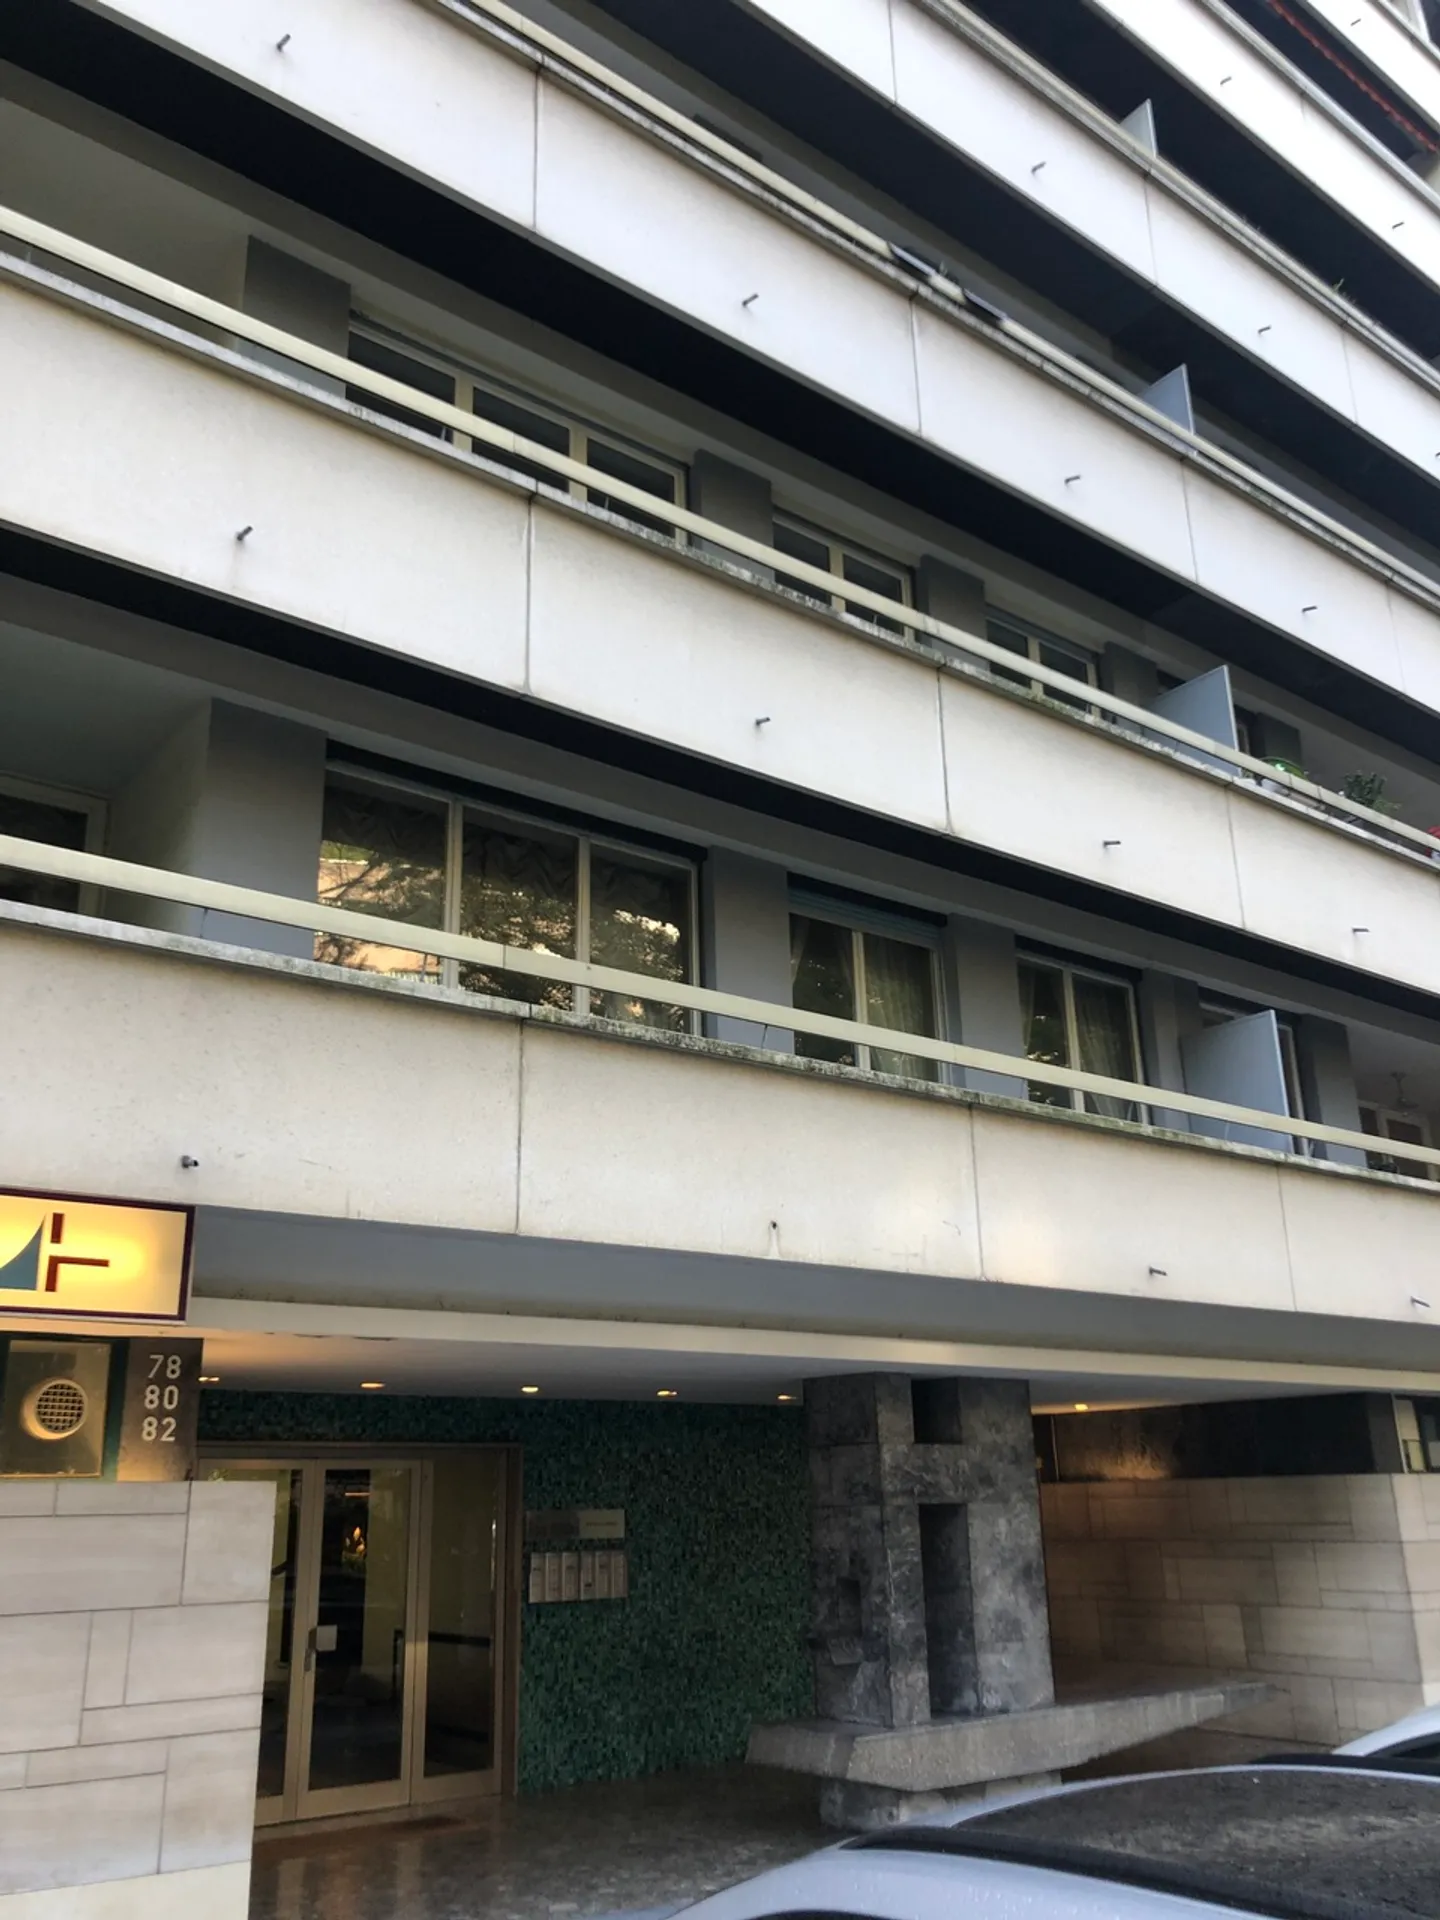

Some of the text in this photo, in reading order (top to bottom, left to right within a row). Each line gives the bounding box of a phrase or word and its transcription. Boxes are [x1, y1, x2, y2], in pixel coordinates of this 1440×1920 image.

[148, 1355, 182, 1379] 78
[144, 1385, 179, 1410] 80
[141, 1416, 177, 1442] 82
